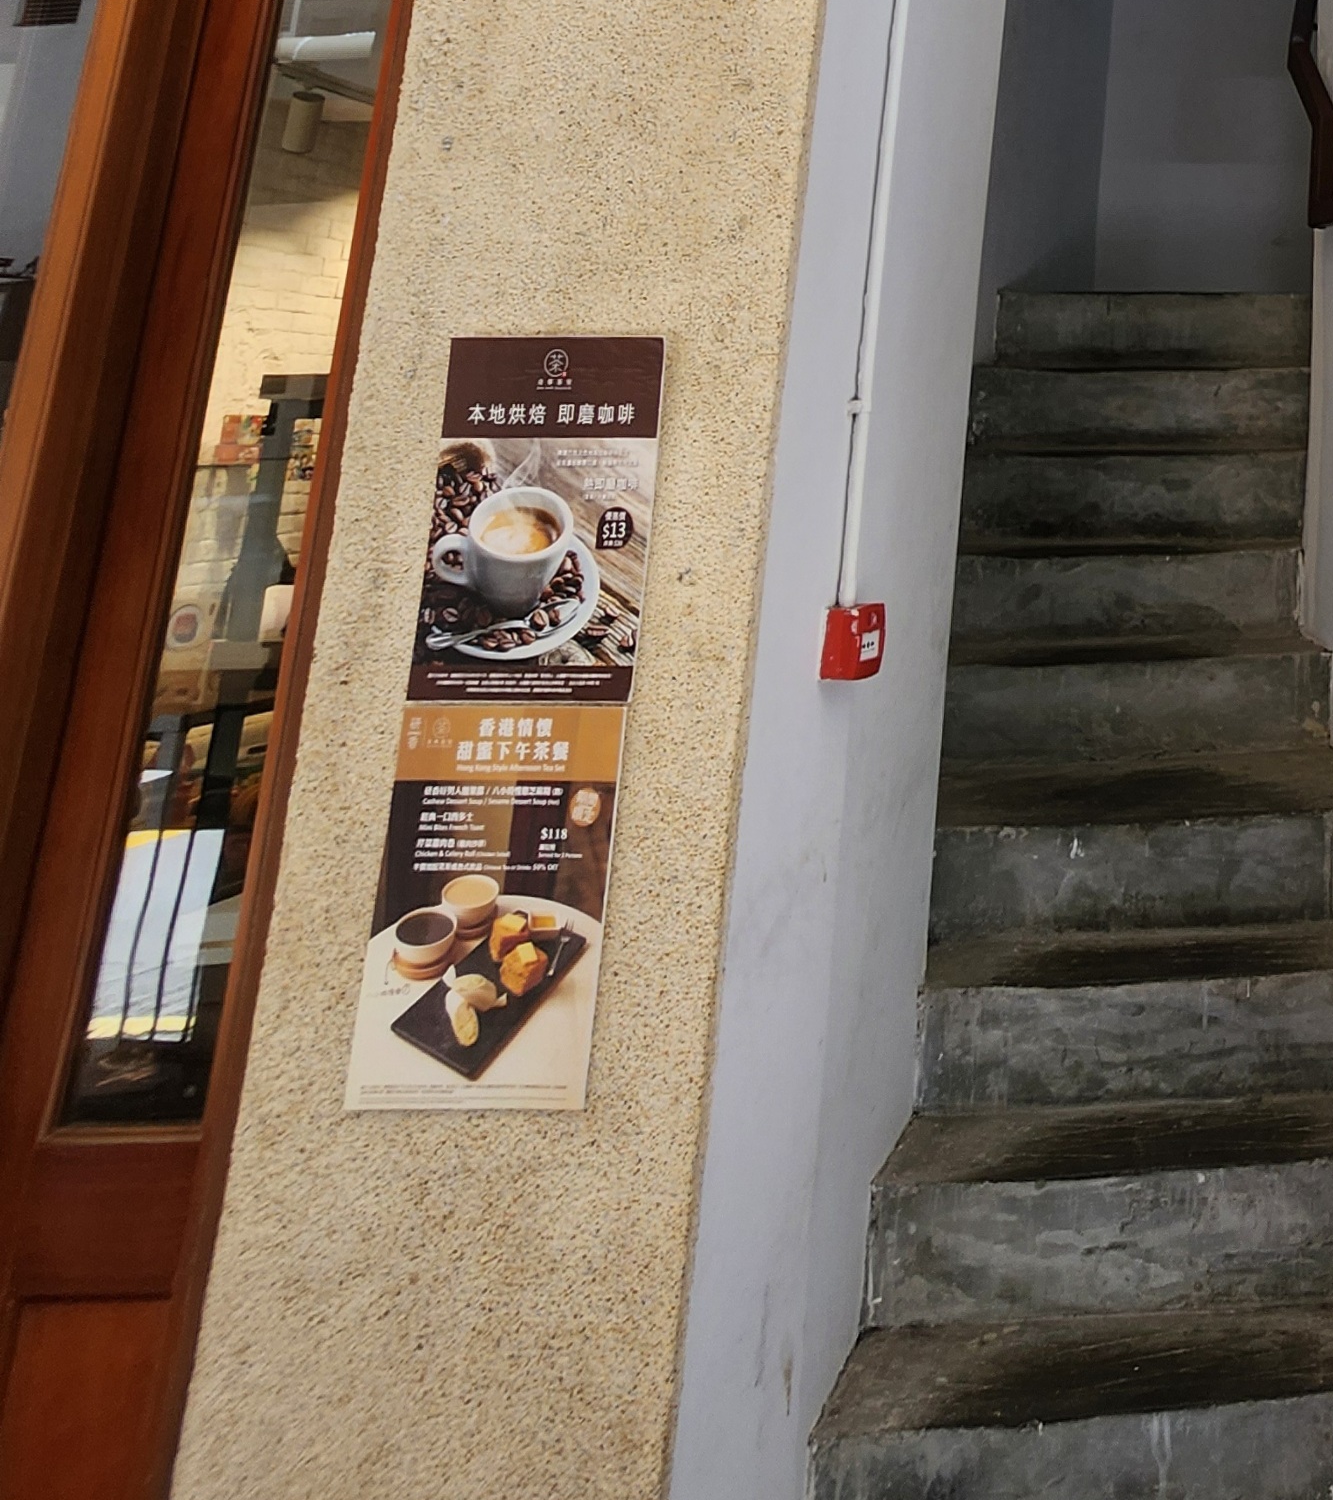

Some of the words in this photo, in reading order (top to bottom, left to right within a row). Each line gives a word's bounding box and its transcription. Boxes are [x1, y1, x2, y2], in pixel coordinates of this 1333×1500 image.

[548, 353, 565, 373] 茶
[467, 403, 547, 426] 本地烘焙
[556, 403, 636, 426] 即磨咖啡
[602, 522, 626, 539] $13
[478, 717, 553, 738] 香港情懷
[456, 740, 569, 761] 甜蜜下午茶餐
[540, 827, 568, 840] $118
